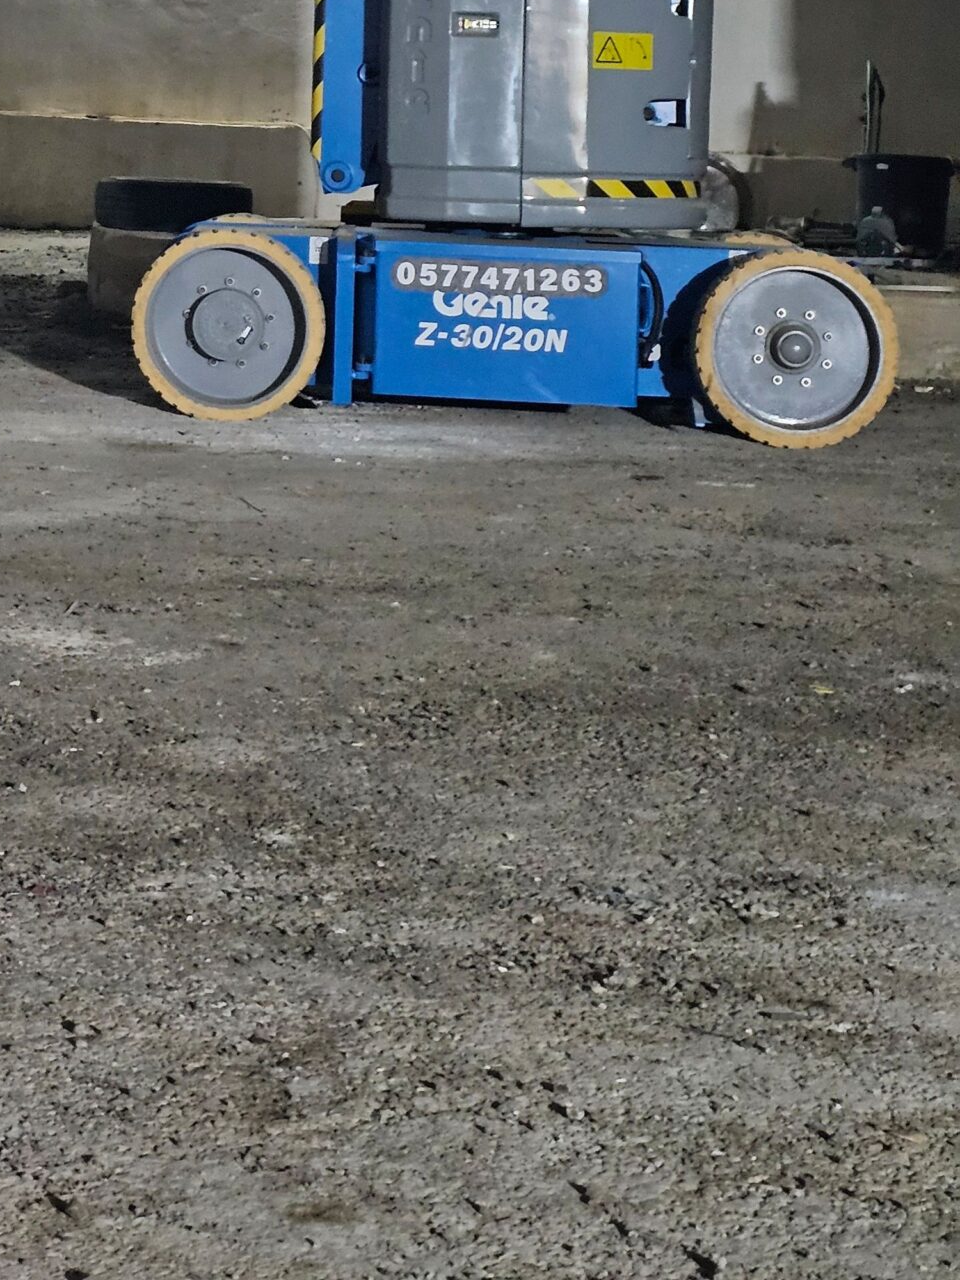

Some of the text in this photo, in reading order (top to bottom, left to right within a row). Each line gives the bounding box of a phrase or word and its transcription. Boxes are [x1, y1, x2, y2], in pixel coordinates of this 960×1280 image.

[396, 261, 603, 293] 0577471263
[432, 286, 549, 321] Genie
[414, 321, 568, 353] Z-30/20N
